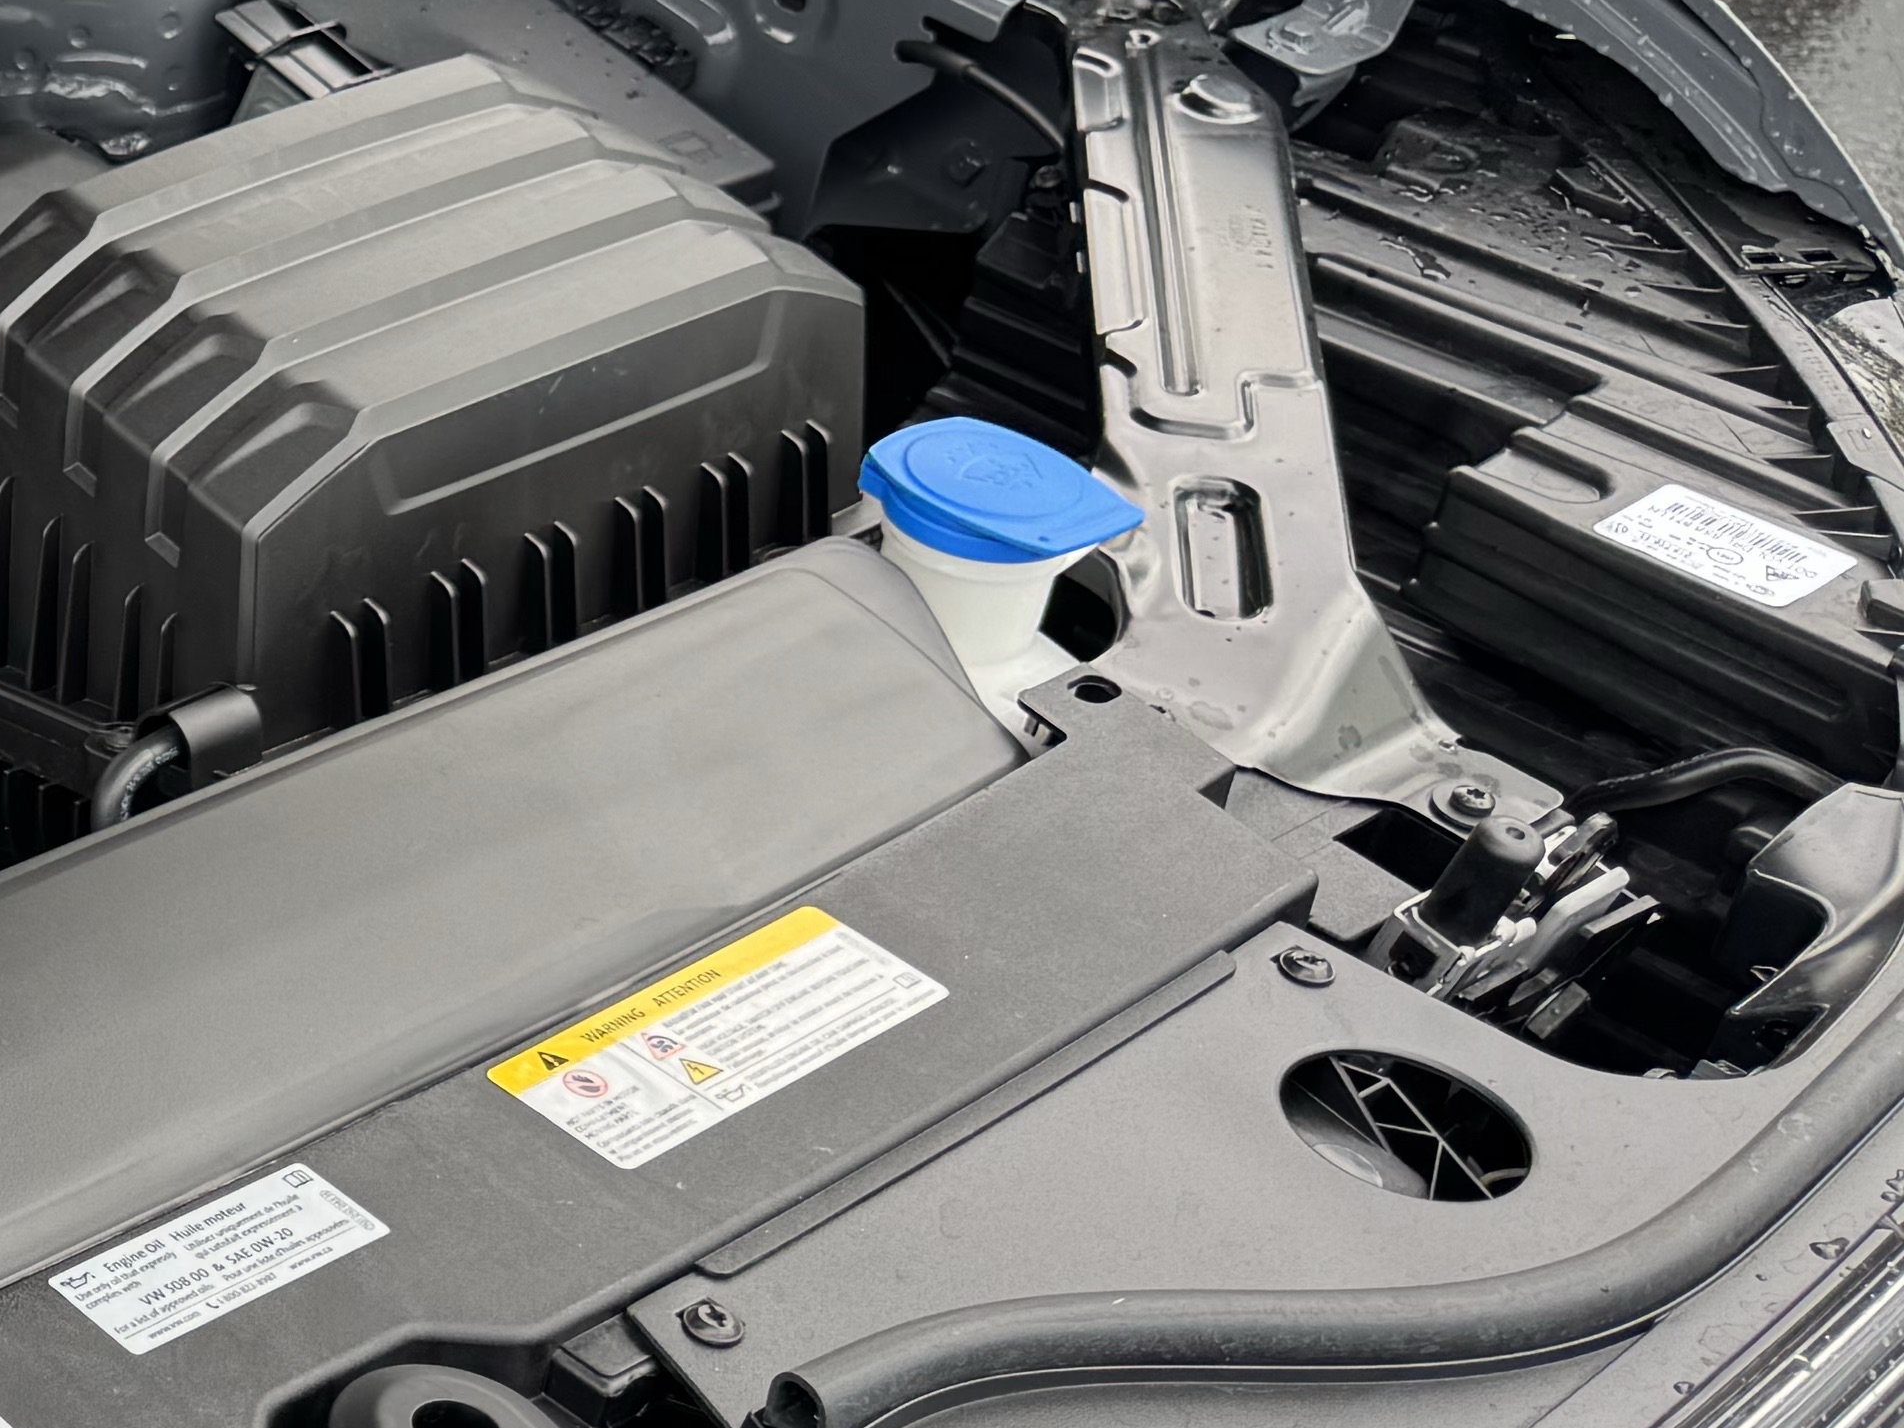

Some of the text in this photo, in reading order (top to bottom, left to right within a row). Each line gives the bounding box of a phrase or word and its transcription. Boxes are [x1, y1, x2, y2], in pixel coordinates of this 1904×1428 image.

[578, 967, 723, 1044] WARNING ATTENTION
[103, 1201, 248, 1274] Engine Oil Huile moteur
[137, 1226, 296, 1306] VW 508 00 & SAE 0W-20
[120, 1279, 143, 1292] with
